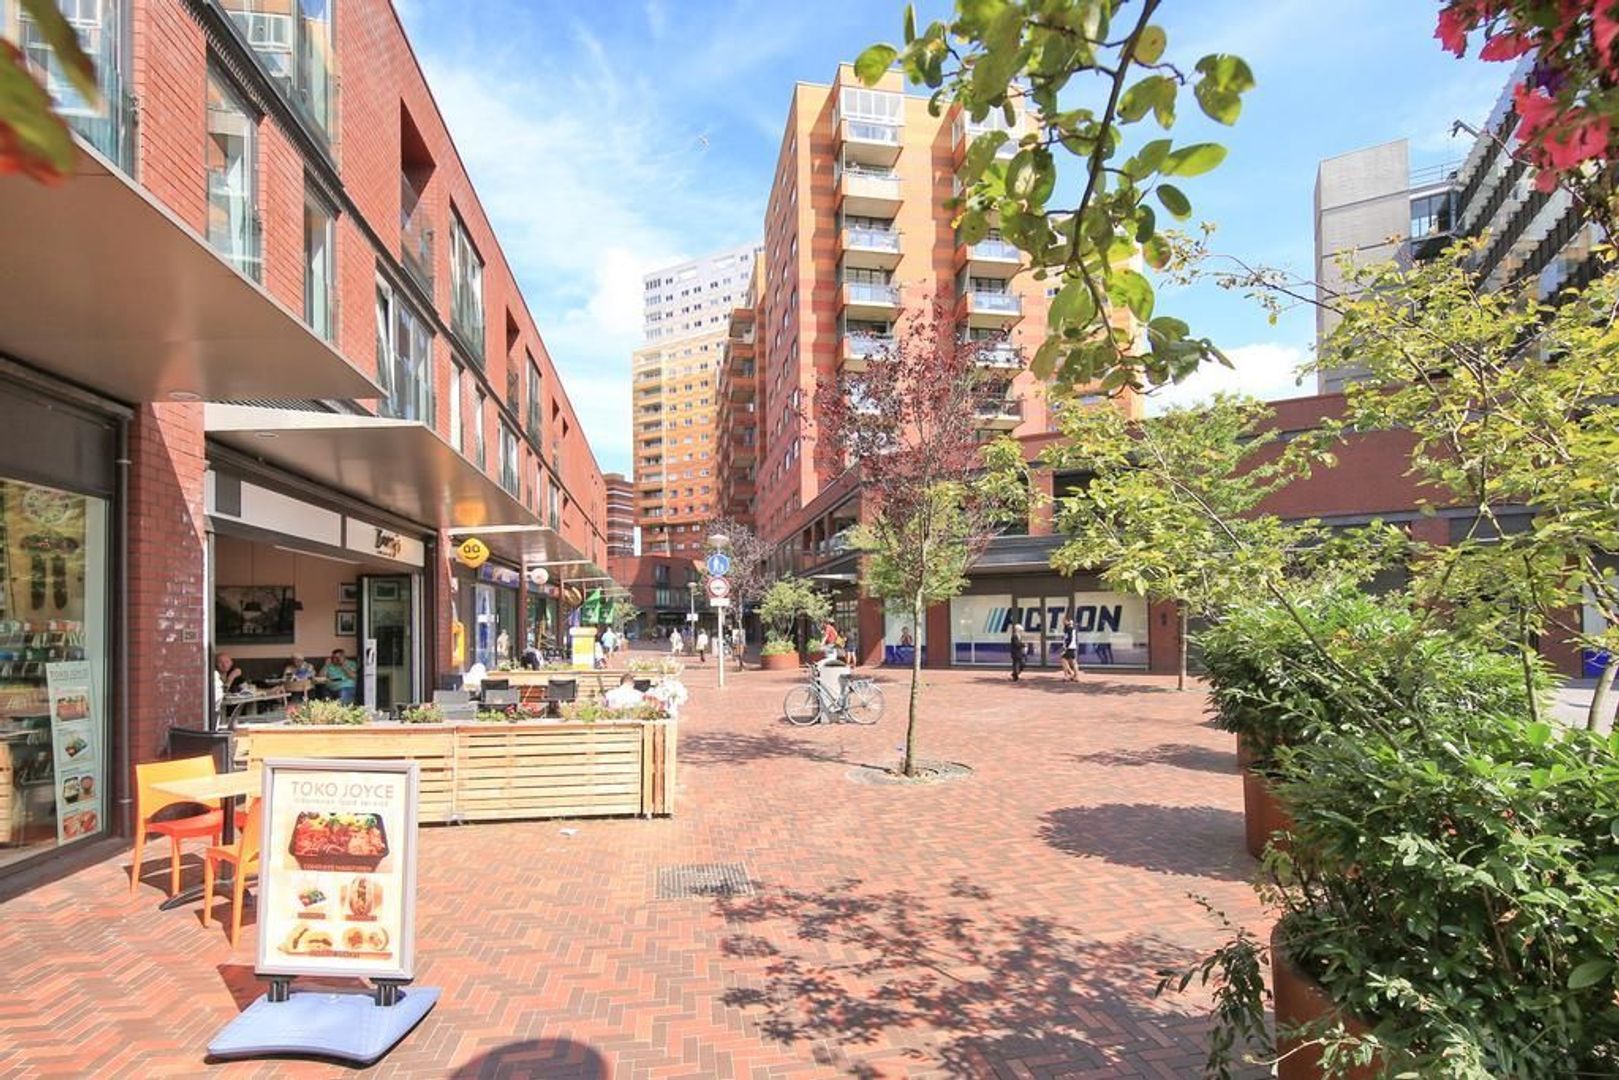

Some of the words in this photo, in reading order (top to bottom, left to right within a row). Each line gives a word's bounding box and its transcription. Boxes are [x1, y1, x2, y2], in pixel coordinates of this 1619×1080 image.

[1001, 605, 1122, 633] ACTON
[291, 781, 338, 797] TOKO
[342, 783, 395, 799] JOYCE
